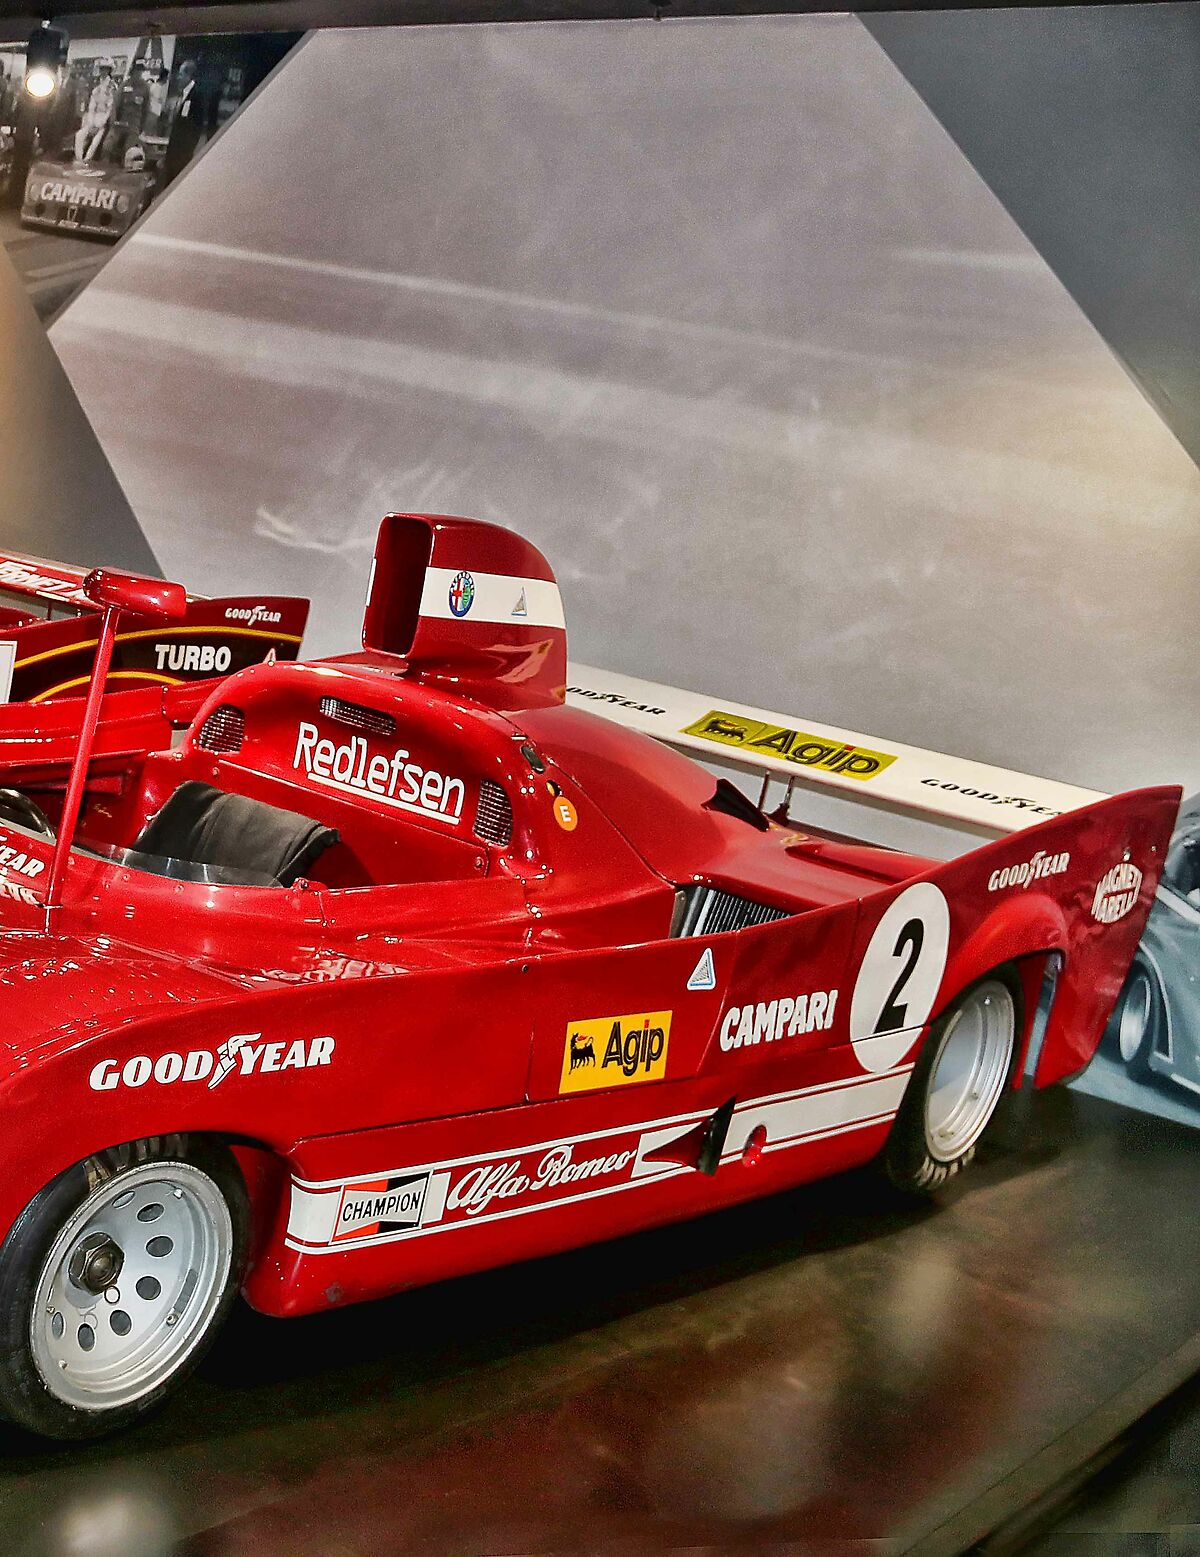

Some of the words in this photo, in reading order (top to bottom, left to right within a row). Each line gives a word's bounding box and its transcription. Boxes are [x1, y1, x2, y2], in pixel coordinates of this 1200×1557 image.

[41, 182, 118, 210] CAMPARI
[155, 643, 232, 672] TURBO
[293, 720, 466, 820] Redlefsen
[748, 728, 881, 776] Agip
[560, 805, 572, 823] E
[874, 917, 925, 1035] 2
[719, 989, 839, 1052] CAMPARI
[601, 1019, 665, 1077] Agip
[446, 1159, 532, 1214] Alfa
[528, 1144, 637, 1190] Romeo
[342, 1189, 423, 1223] CHAMPION
